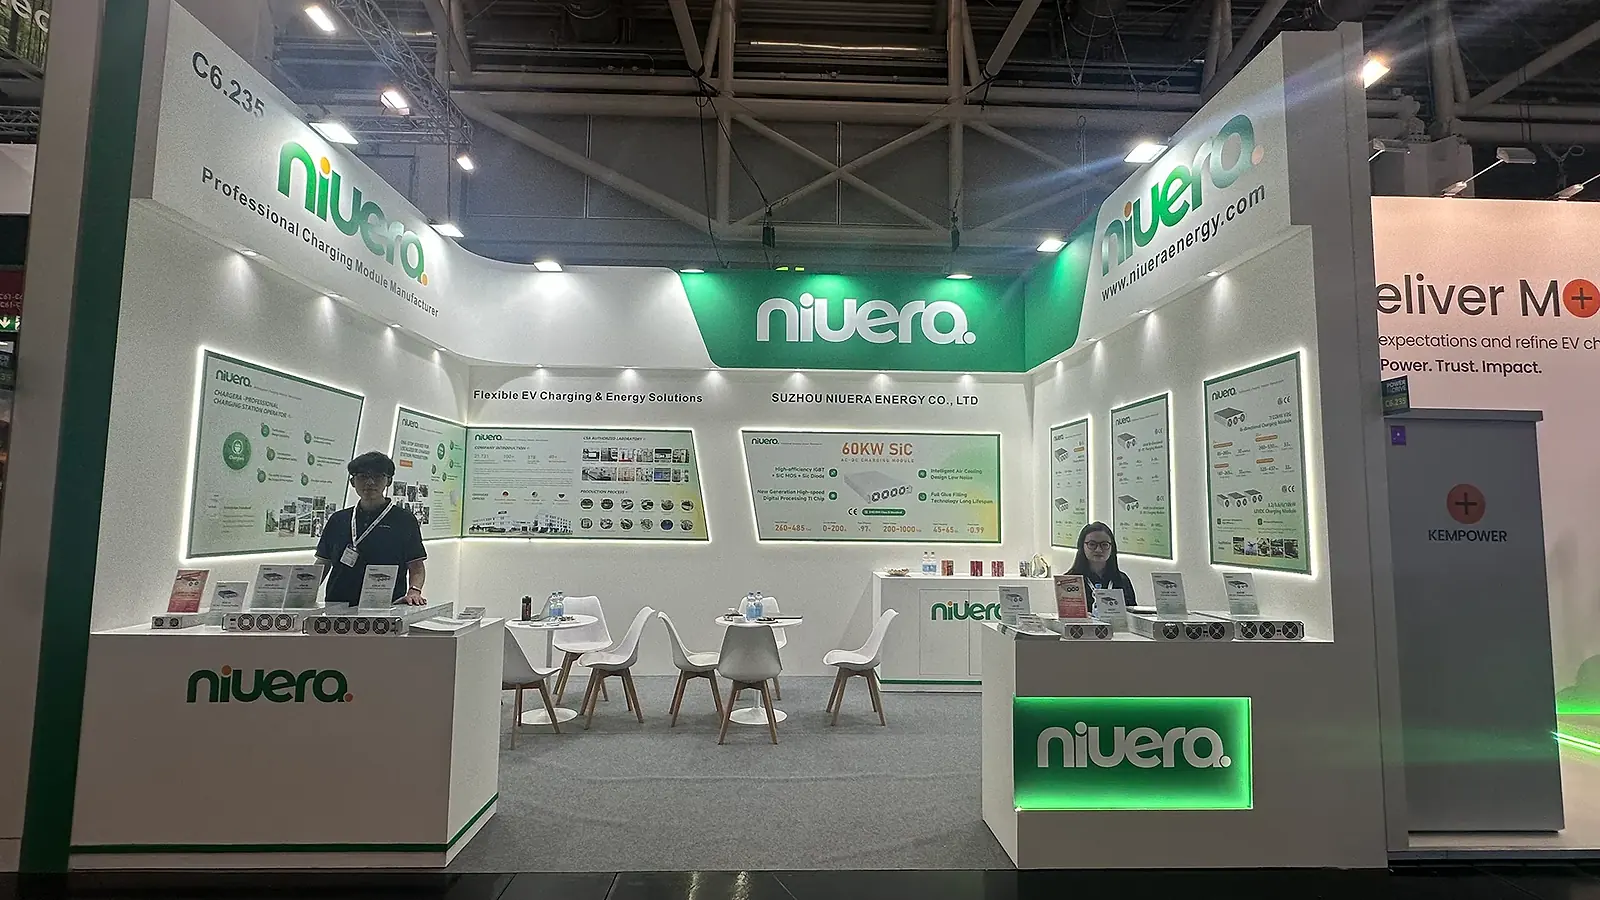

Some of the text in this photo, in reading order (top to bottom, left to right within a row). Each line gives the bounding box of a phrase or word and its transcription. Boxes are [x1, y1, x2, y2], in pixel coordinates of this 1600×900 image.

[192, 51, 265, 118] C6.235
[201, 166, 439, 318] Professional Charging Module Manufacturer
[1101, 183, 1266, 301] www.niueraenergy.com
[1376, 273, 1505, 316] eliver
[1378, 334, 1600, 350] expectations and refine EV ch
[1380, 358, 1543, 377] Power. Trust. Impact.
[473, 390, 703, 404] Flexible EV Charging & Energy Solutions
[771, 392, 979, 406] SUZHOU NIUERA ENERGY CO., LTD
[842, 442, 913, 456] 60KW SiC
[1428, 529, 1507, 542] KEMPOWER
